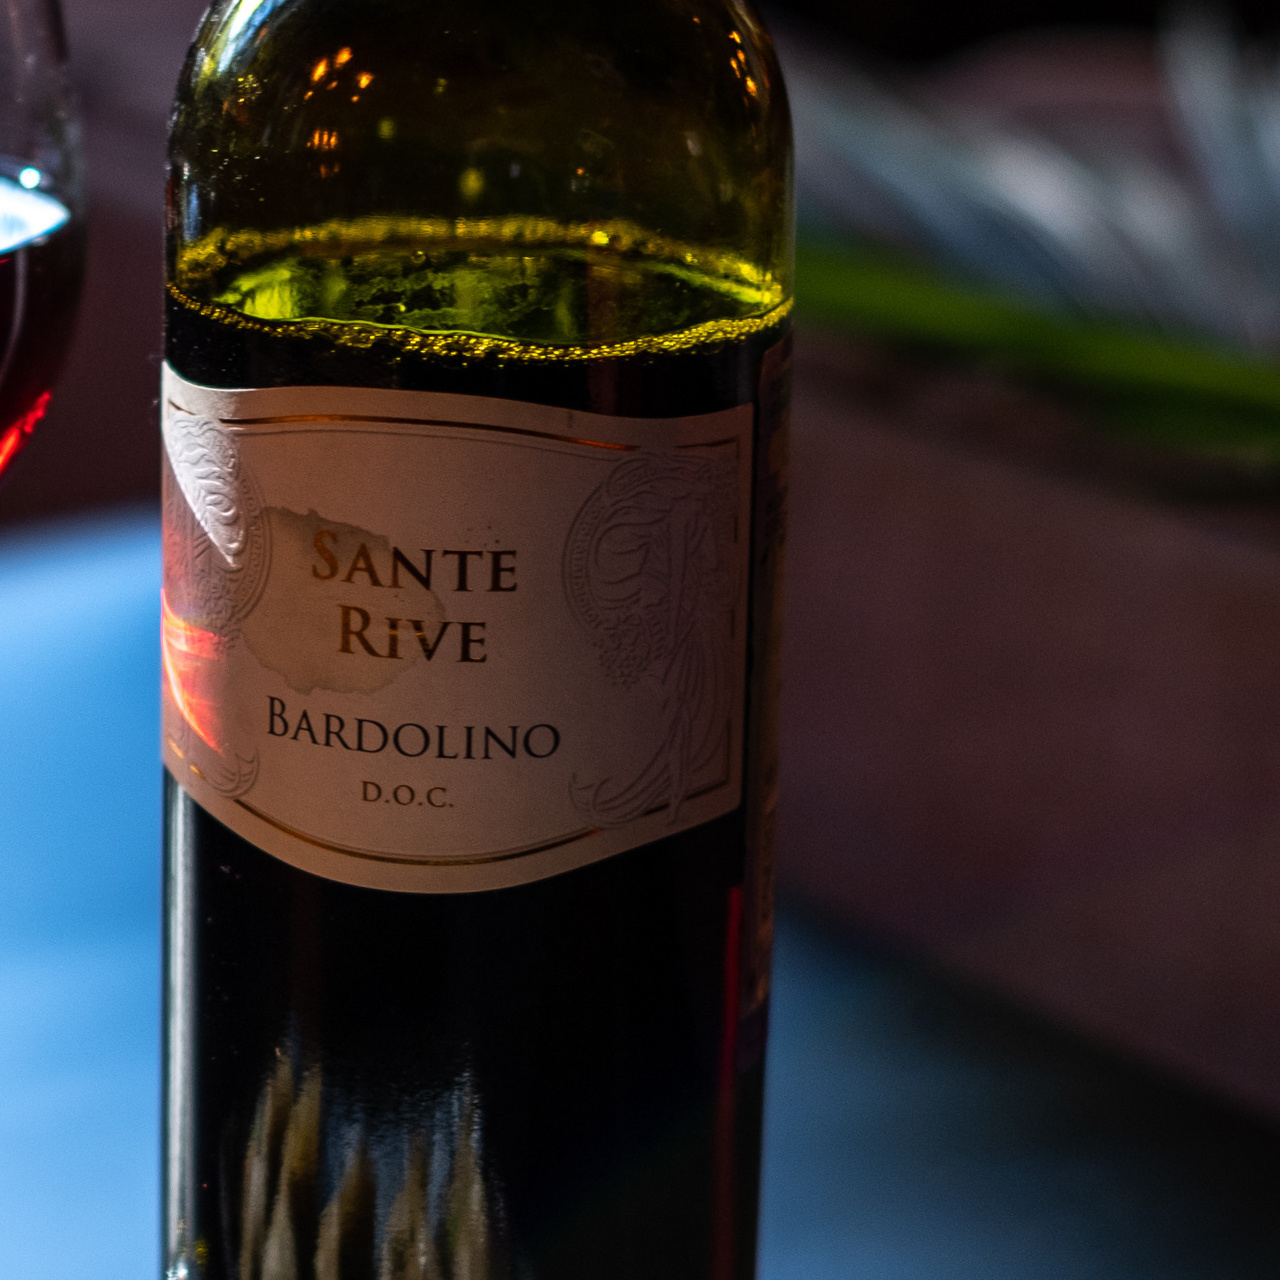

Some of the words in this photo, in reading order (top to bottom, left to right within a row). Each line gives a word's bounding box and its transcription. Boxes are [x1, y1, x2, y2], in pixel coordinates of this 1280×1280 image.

[312, 530, 518, 592] SANTE
[337, 603, 487, 664] RIVE
[266, 696, 560, 759] BARDOLINO
[361, 781, 455, 808] D.O.C.
